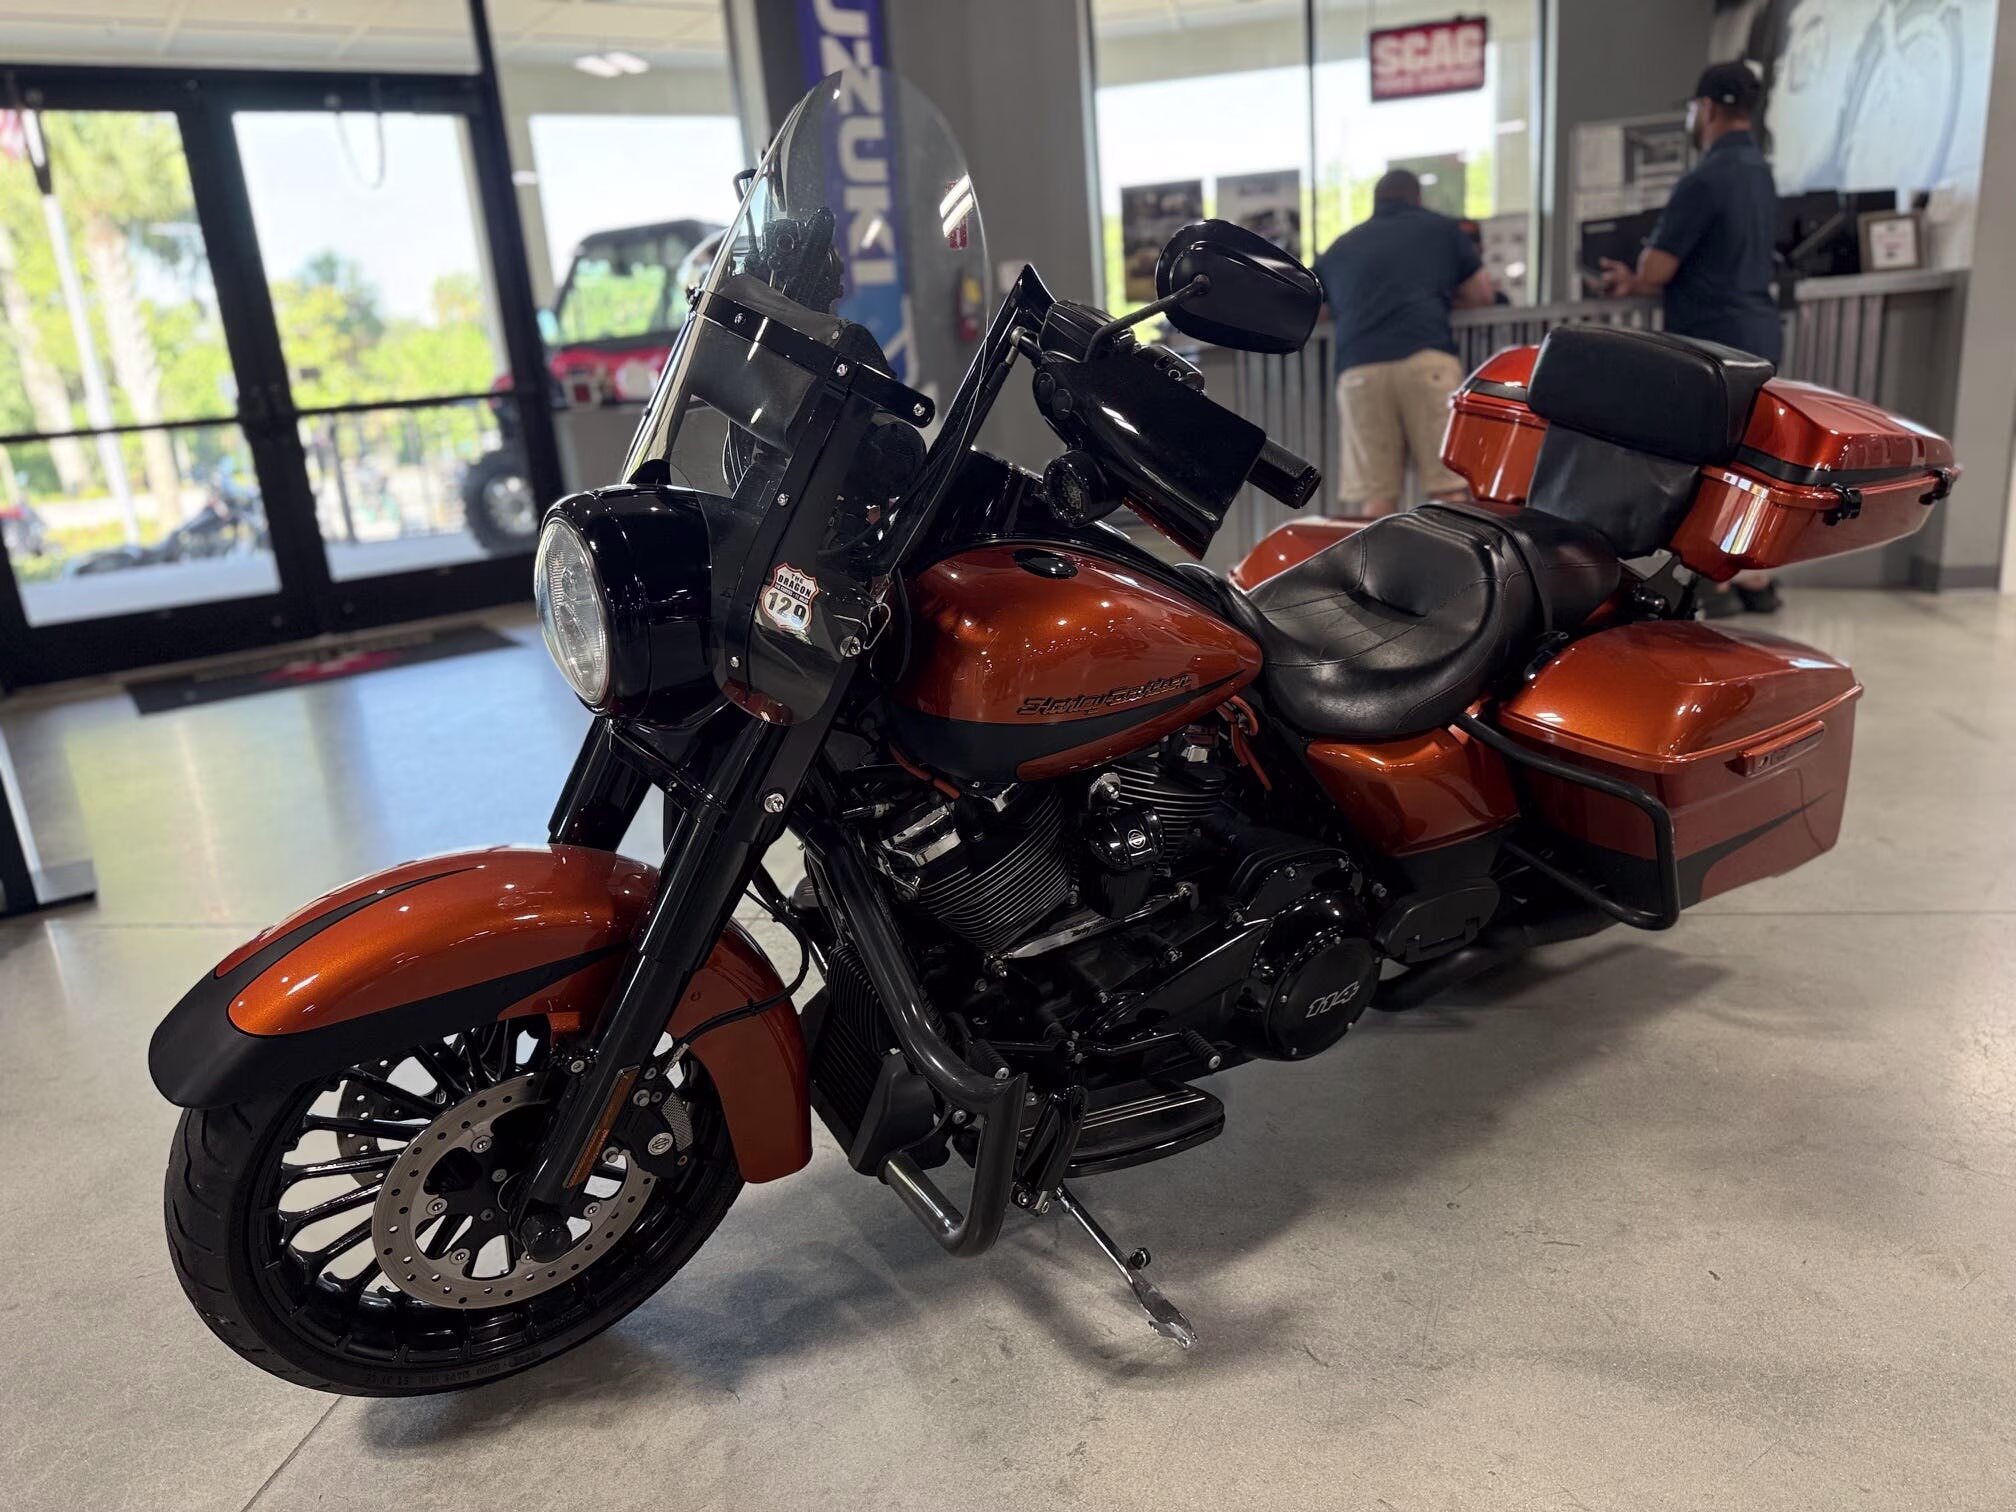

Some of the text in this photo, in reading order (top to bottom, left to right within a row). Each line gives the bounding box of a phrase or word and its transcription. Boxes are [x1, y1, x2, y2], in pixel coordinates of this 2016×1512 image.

[1373, 25, 1481, 73] SCAG
[777, 574, 812, 598] DRAGON
[791, 573, 805, 584] THE
[1305, 981, 1360, 1019] 114
